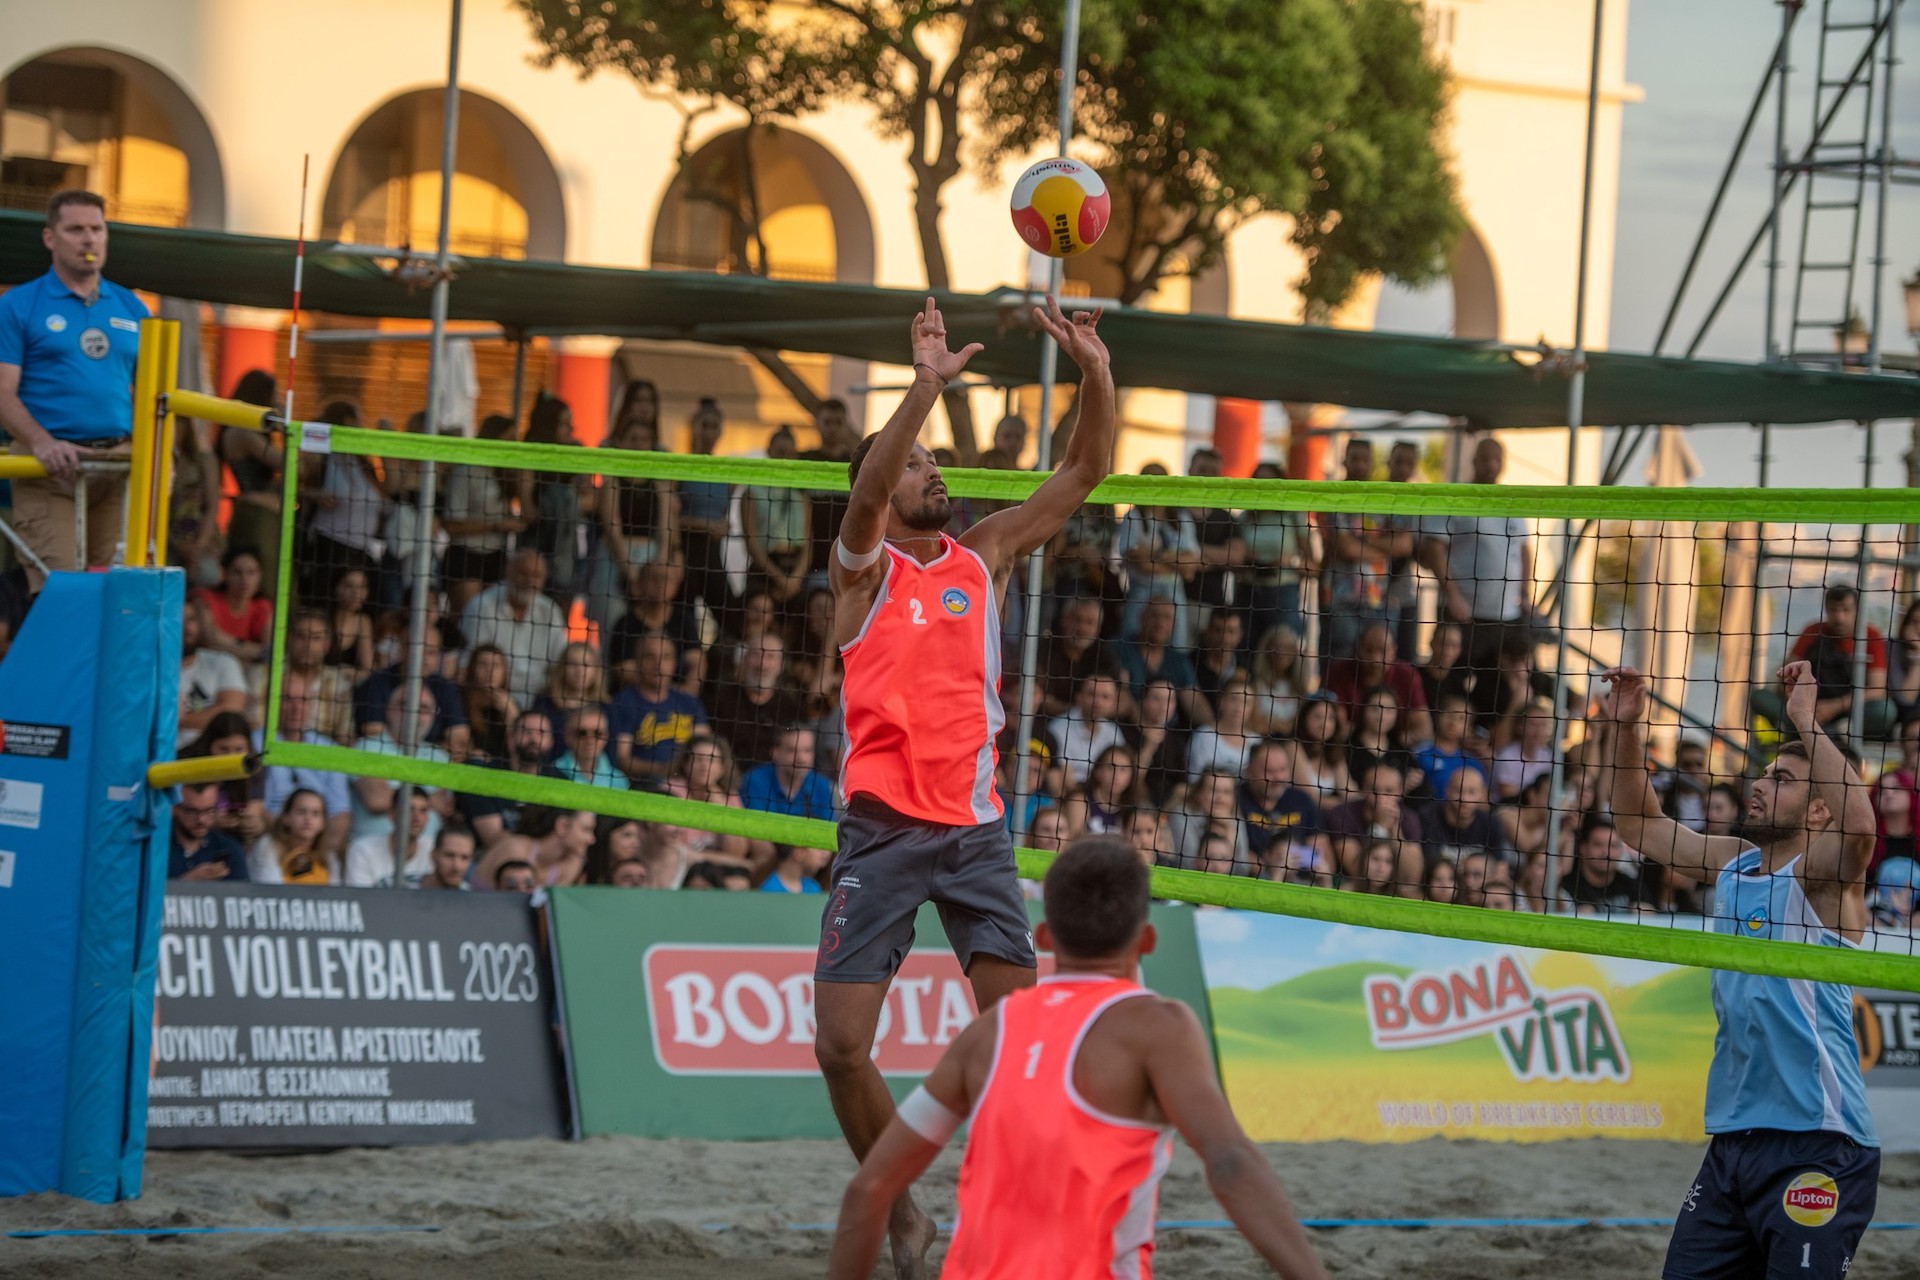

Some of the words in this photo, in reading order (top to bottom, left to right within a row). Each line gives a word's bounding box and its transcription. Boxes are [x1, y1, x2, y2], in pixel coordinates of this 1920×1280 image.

[909, 598, 927, 625] 2
[161, 895, 219, 928] ΗΝΙΟ
[223, 897, 365, 932] ΠΡΩΤΑΘΛΗΜΑ
[834, 917, 848, 927] FIT
[156, 933, 216, 998] CH
[222, 935, 456, 1001] VOLLEYBALL
[459, 941, 540, 1002] 2023
[1369, 954, 1531, 1031] BONA
[250, 1025, 339, 1063] ΠΛΑΤΕΙΑ
[341, 1027, 486, 1064] ΑΡΙΣΤΟΤΕΛΟΥΣ
[1024, 1040, 1043, 1079] 1
[201, 1067, 264, 1097] ΔΗΜΟΣ
[265, 1067, 393, 1097] ΘΕΣΣΑΛΟΝΙΚΗΣ
[218, 1101, 307, 1127] ΠΕΡΙΦΕΡΕΙΑ
[308, 1101, 386, 1126] ΚΕΝΤΡΙΚΗΣ
[1379, 1102, 1448, 1128] WORLD
[1452, 1102, 1474, 1127] OF
[1479, 1102, 1581, 1127] BREAKFAST
[1586, 1102, 1663, 1128] CEREALS
[1790, 1192, 1833, 1206] Lipton
[1801, 1243, 1811, 1268] 1
